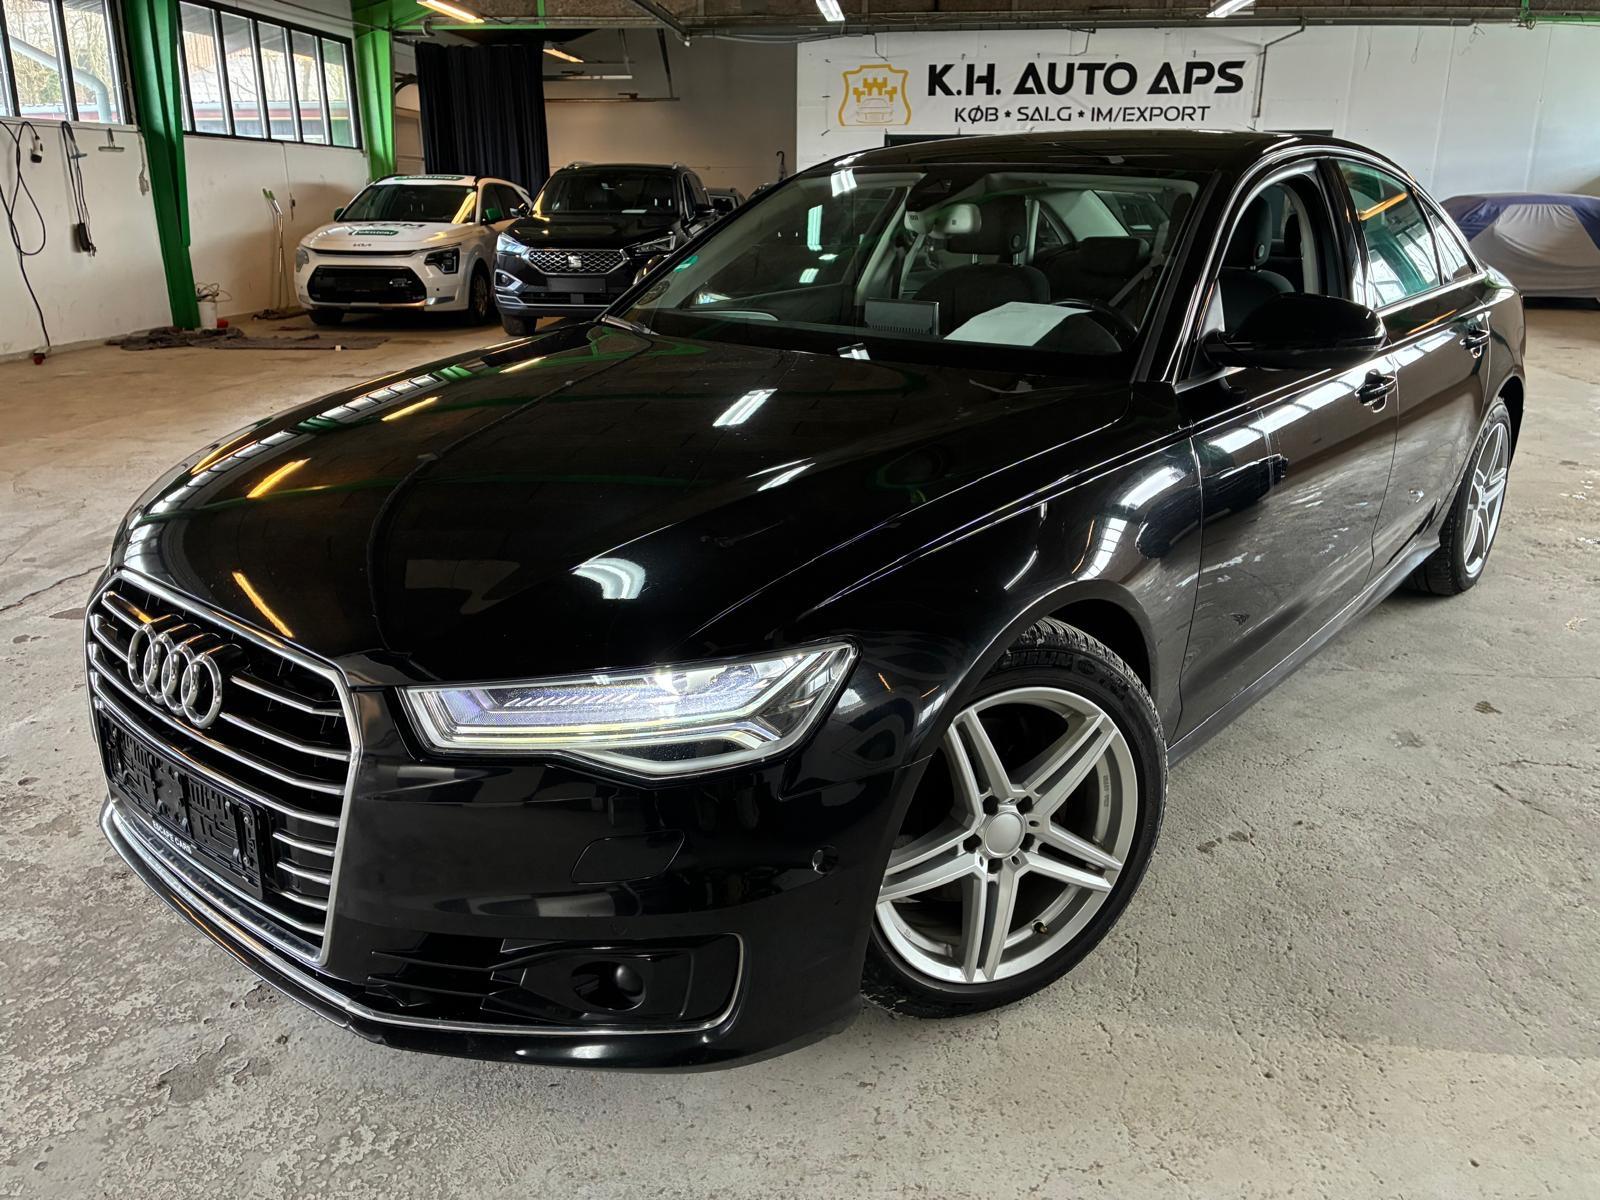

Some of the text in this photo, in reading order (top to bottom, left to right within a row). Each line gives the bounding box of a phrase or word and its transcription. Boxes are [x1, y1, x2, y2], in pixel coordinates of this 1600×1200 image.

[927, 60, 1246, 97] K.H. AUTO APS
[954, 104, 1211, 125] KØB SALG IM/EXPORT
[174, 837, 192, 855] CARS
